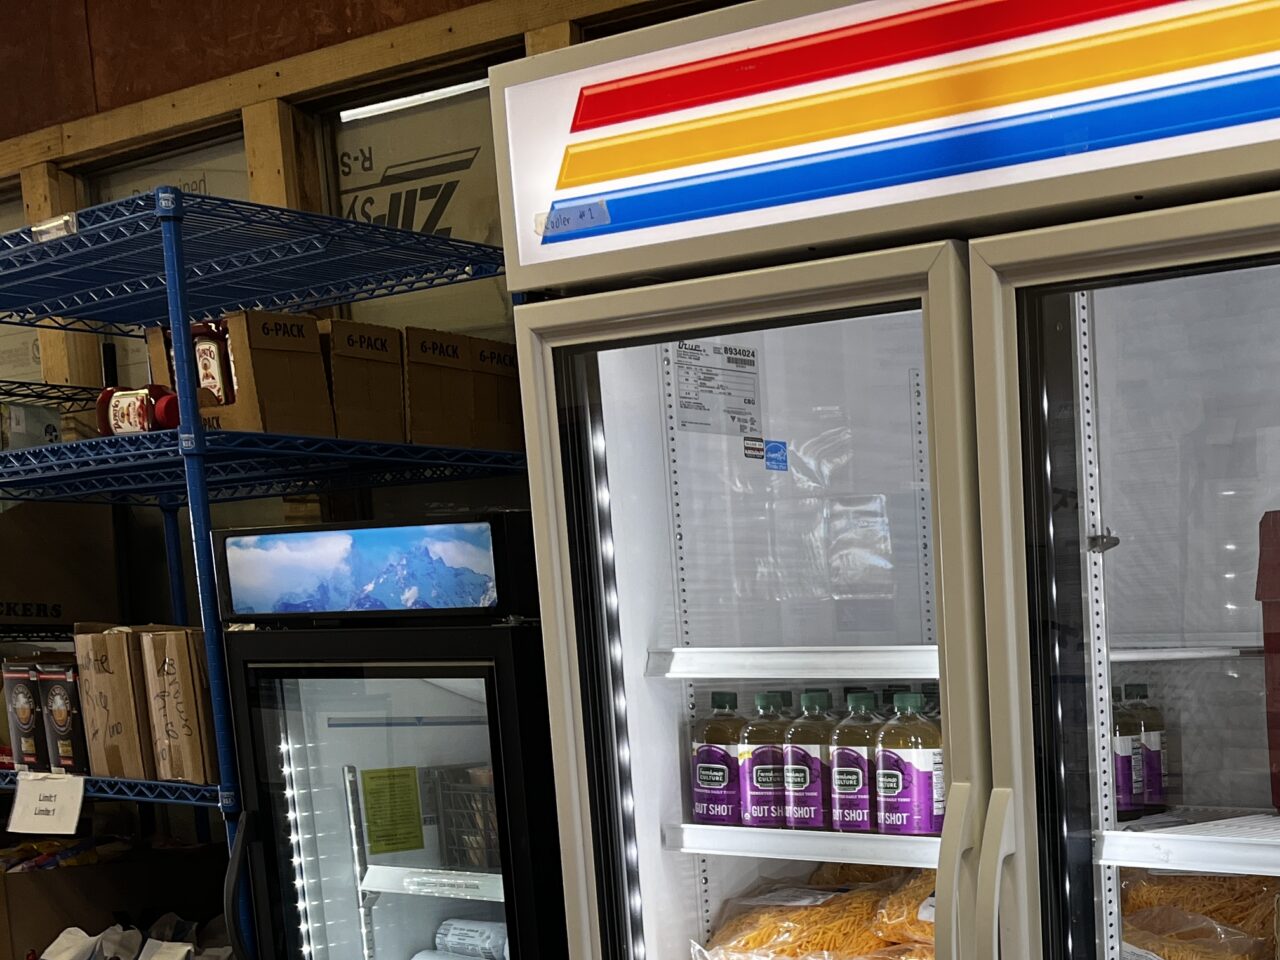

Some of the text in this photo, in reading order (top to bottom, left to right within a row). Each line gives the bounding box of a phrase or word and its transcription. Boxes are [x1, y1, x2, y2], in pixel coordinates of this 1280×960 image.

[261, 321, 305, 339] 6-PACK
[346, 334, 389, 353] 6-PACK
[420, 339, 460, 360] 6-PACK
[479, 349, 516, 369] 6-PACK
[694, 802, 733, 816] GUT SHOT
[751, 805, 784, 817] GUT SH
[793, 806, 817, 818] SHOT
[844, 809, 869, 821] SHOT
[885, 813, 910, 825] SHOT
